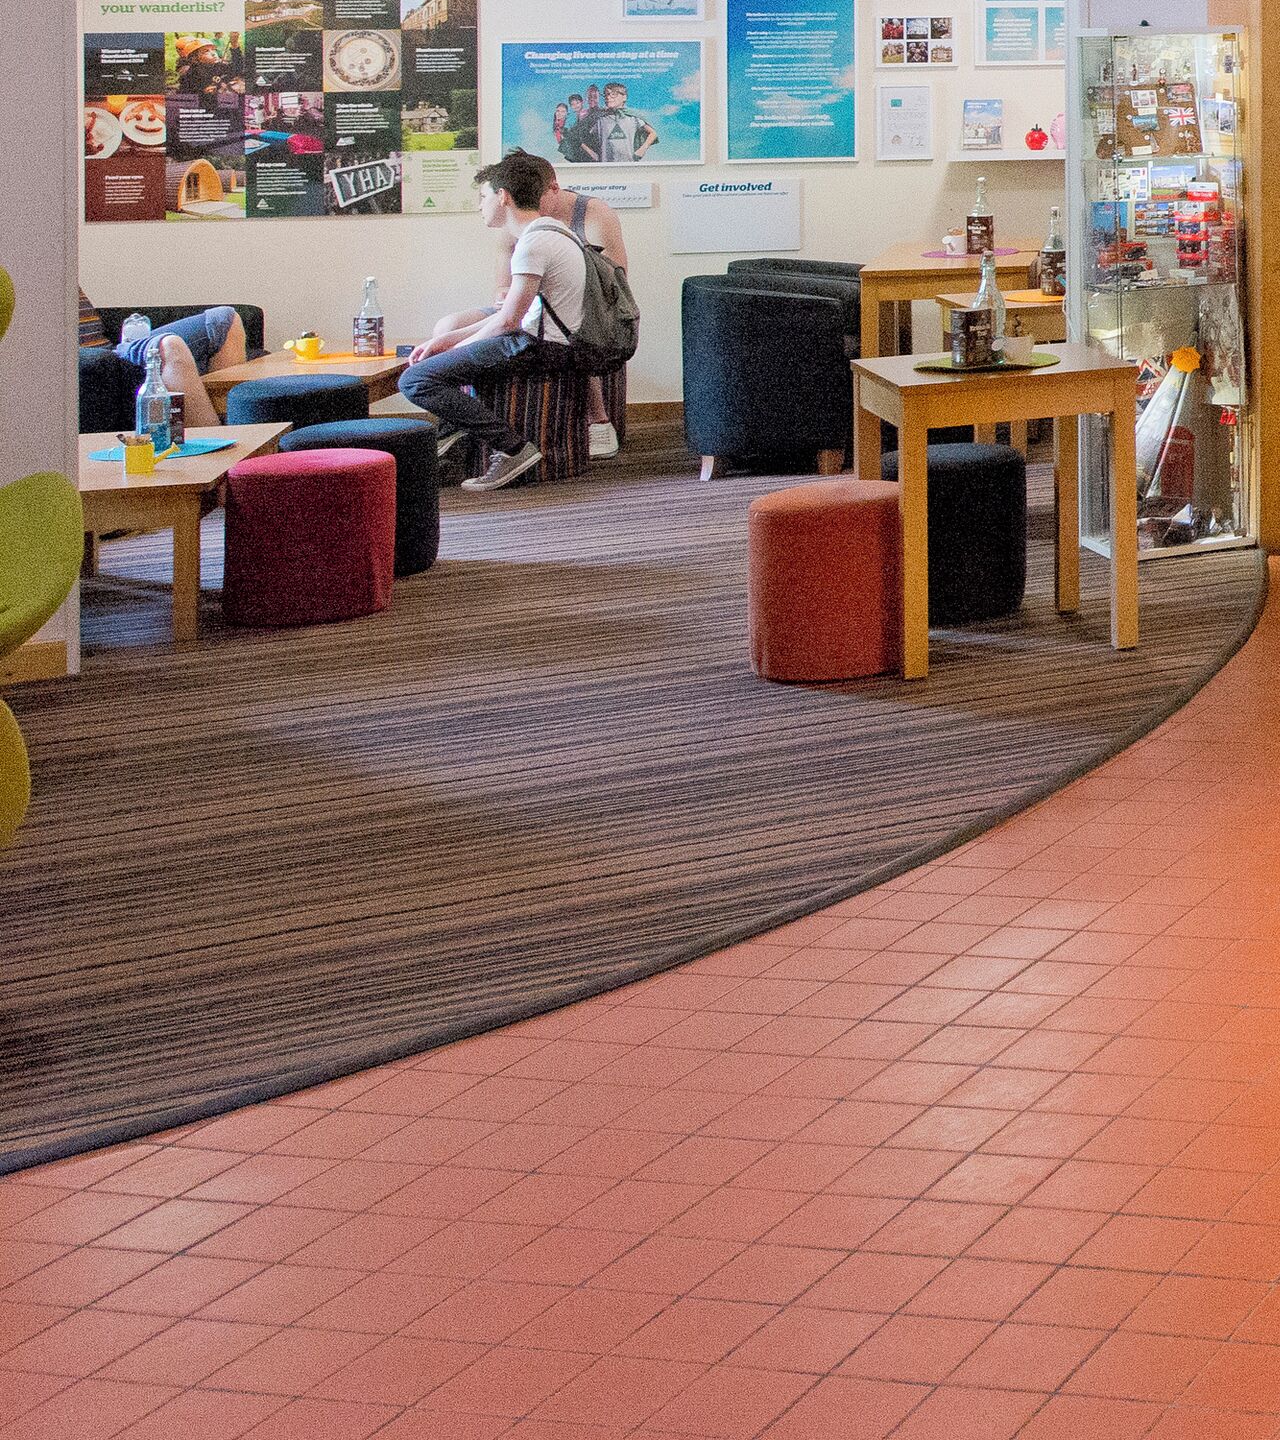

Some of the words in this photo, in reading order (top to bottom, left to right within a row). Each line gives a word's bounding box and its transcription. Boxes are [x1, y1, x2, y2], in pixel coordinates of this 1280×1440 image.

[101, 4, 136, 15] your
[139, 2, 225, 13] wanderlist?
[343, 166, 388, 197] YHA
[699, 183, 719, 193] Get
[721, 182, 772, 192] involved
